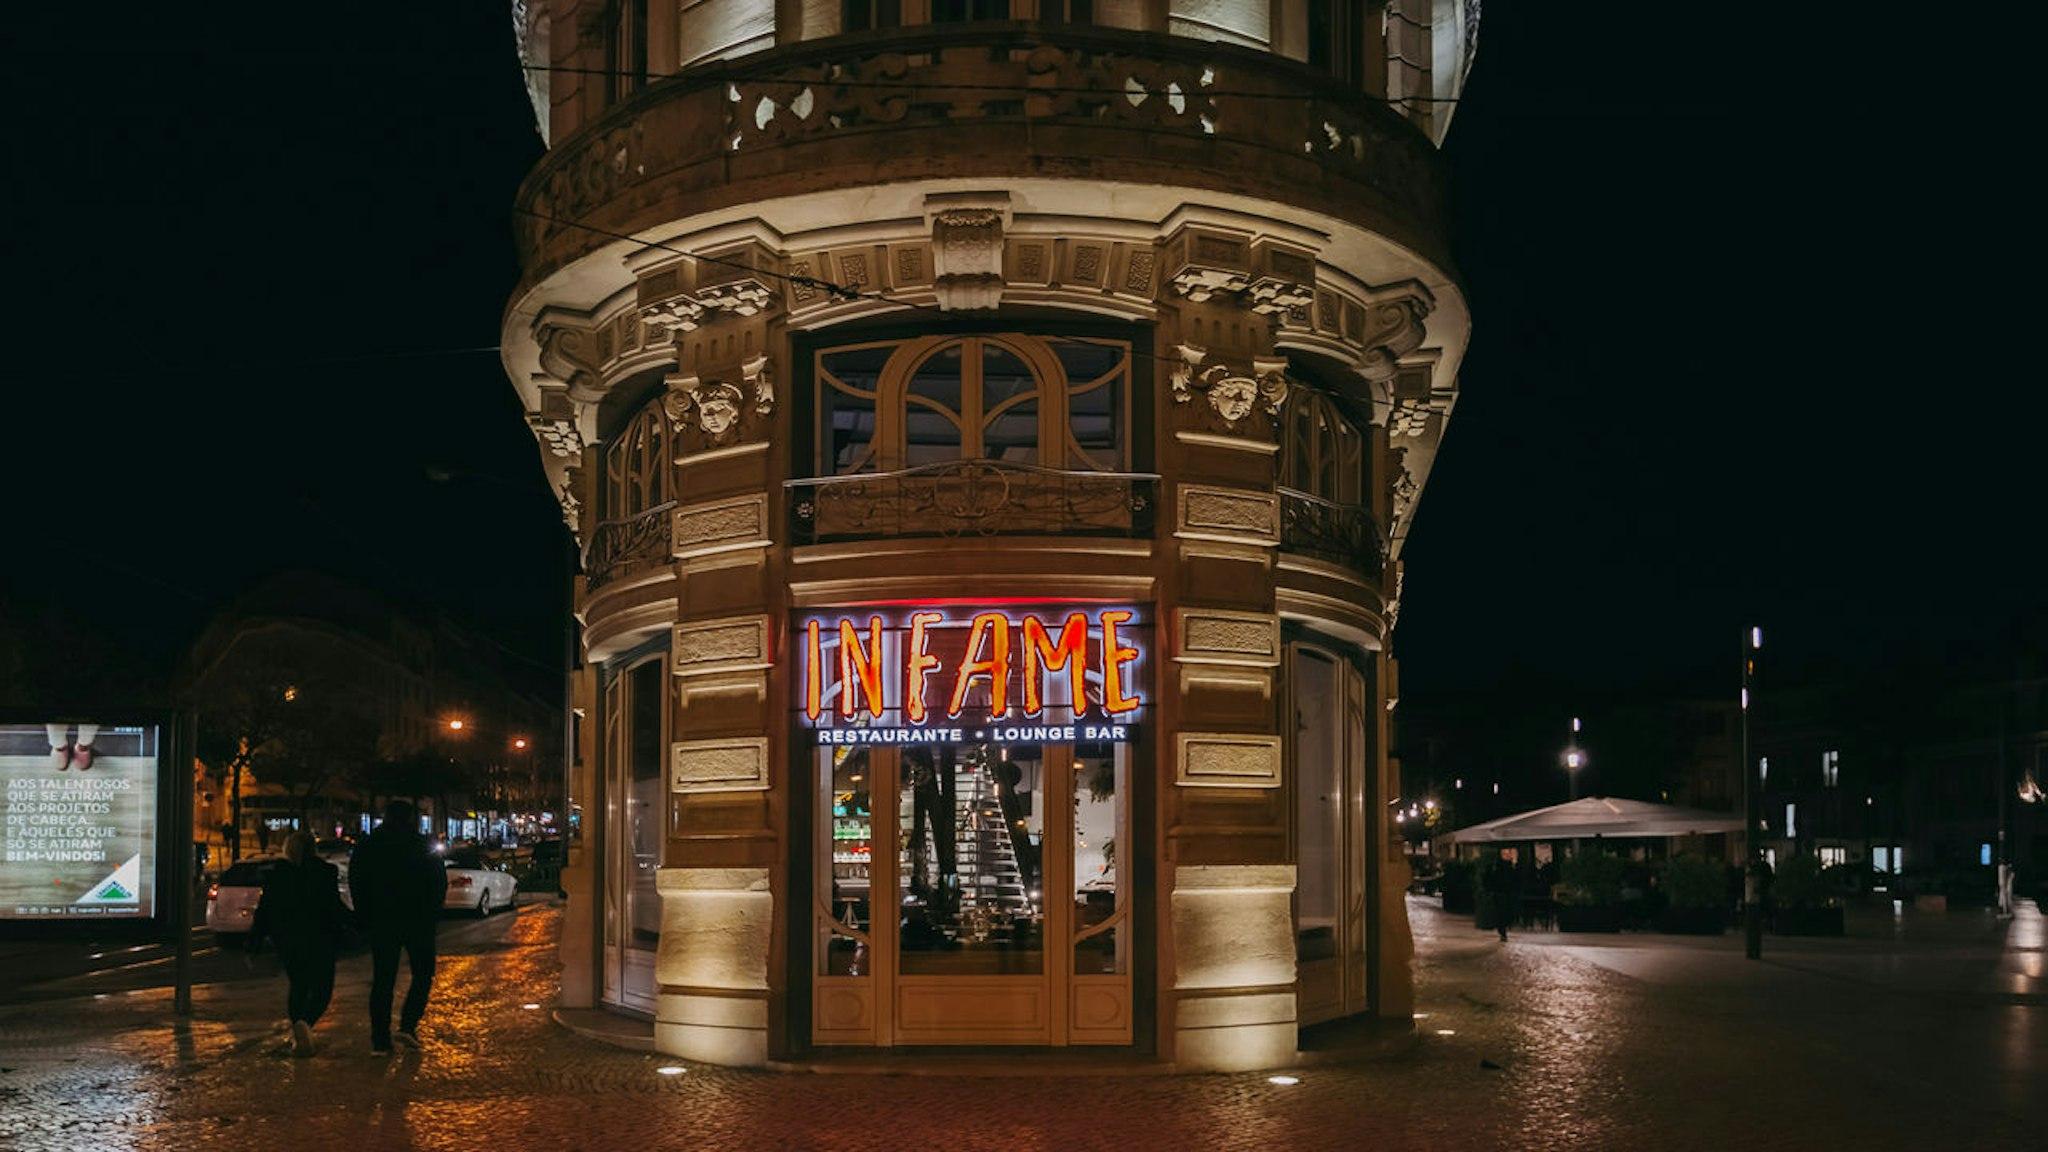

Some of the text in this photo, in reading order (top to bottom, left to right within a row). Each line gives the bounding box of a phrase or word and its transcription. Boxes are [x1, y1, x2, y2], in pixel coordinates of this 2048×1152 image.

[807, 613, 1140, 722] INFAME
[819, 727, 1127, 743] RESTAURANTE LOUNGE BAR
[8, 778, 131, 790] AOS TALENTOSOS
[8, 790, 114, 802] QUE SE ATIRAM
[8, 803, 110, 814] AOS PROJETOS
[7, 815, 26, 825] DE
[7, 827, 15, 838] E
[87, 827, 116, 838] QUE
[28, 839, 46, 849] SE
[50, 839, 102, 849] ATIRAM
[6, 851, 106, 862] BEM-VINDOS!
